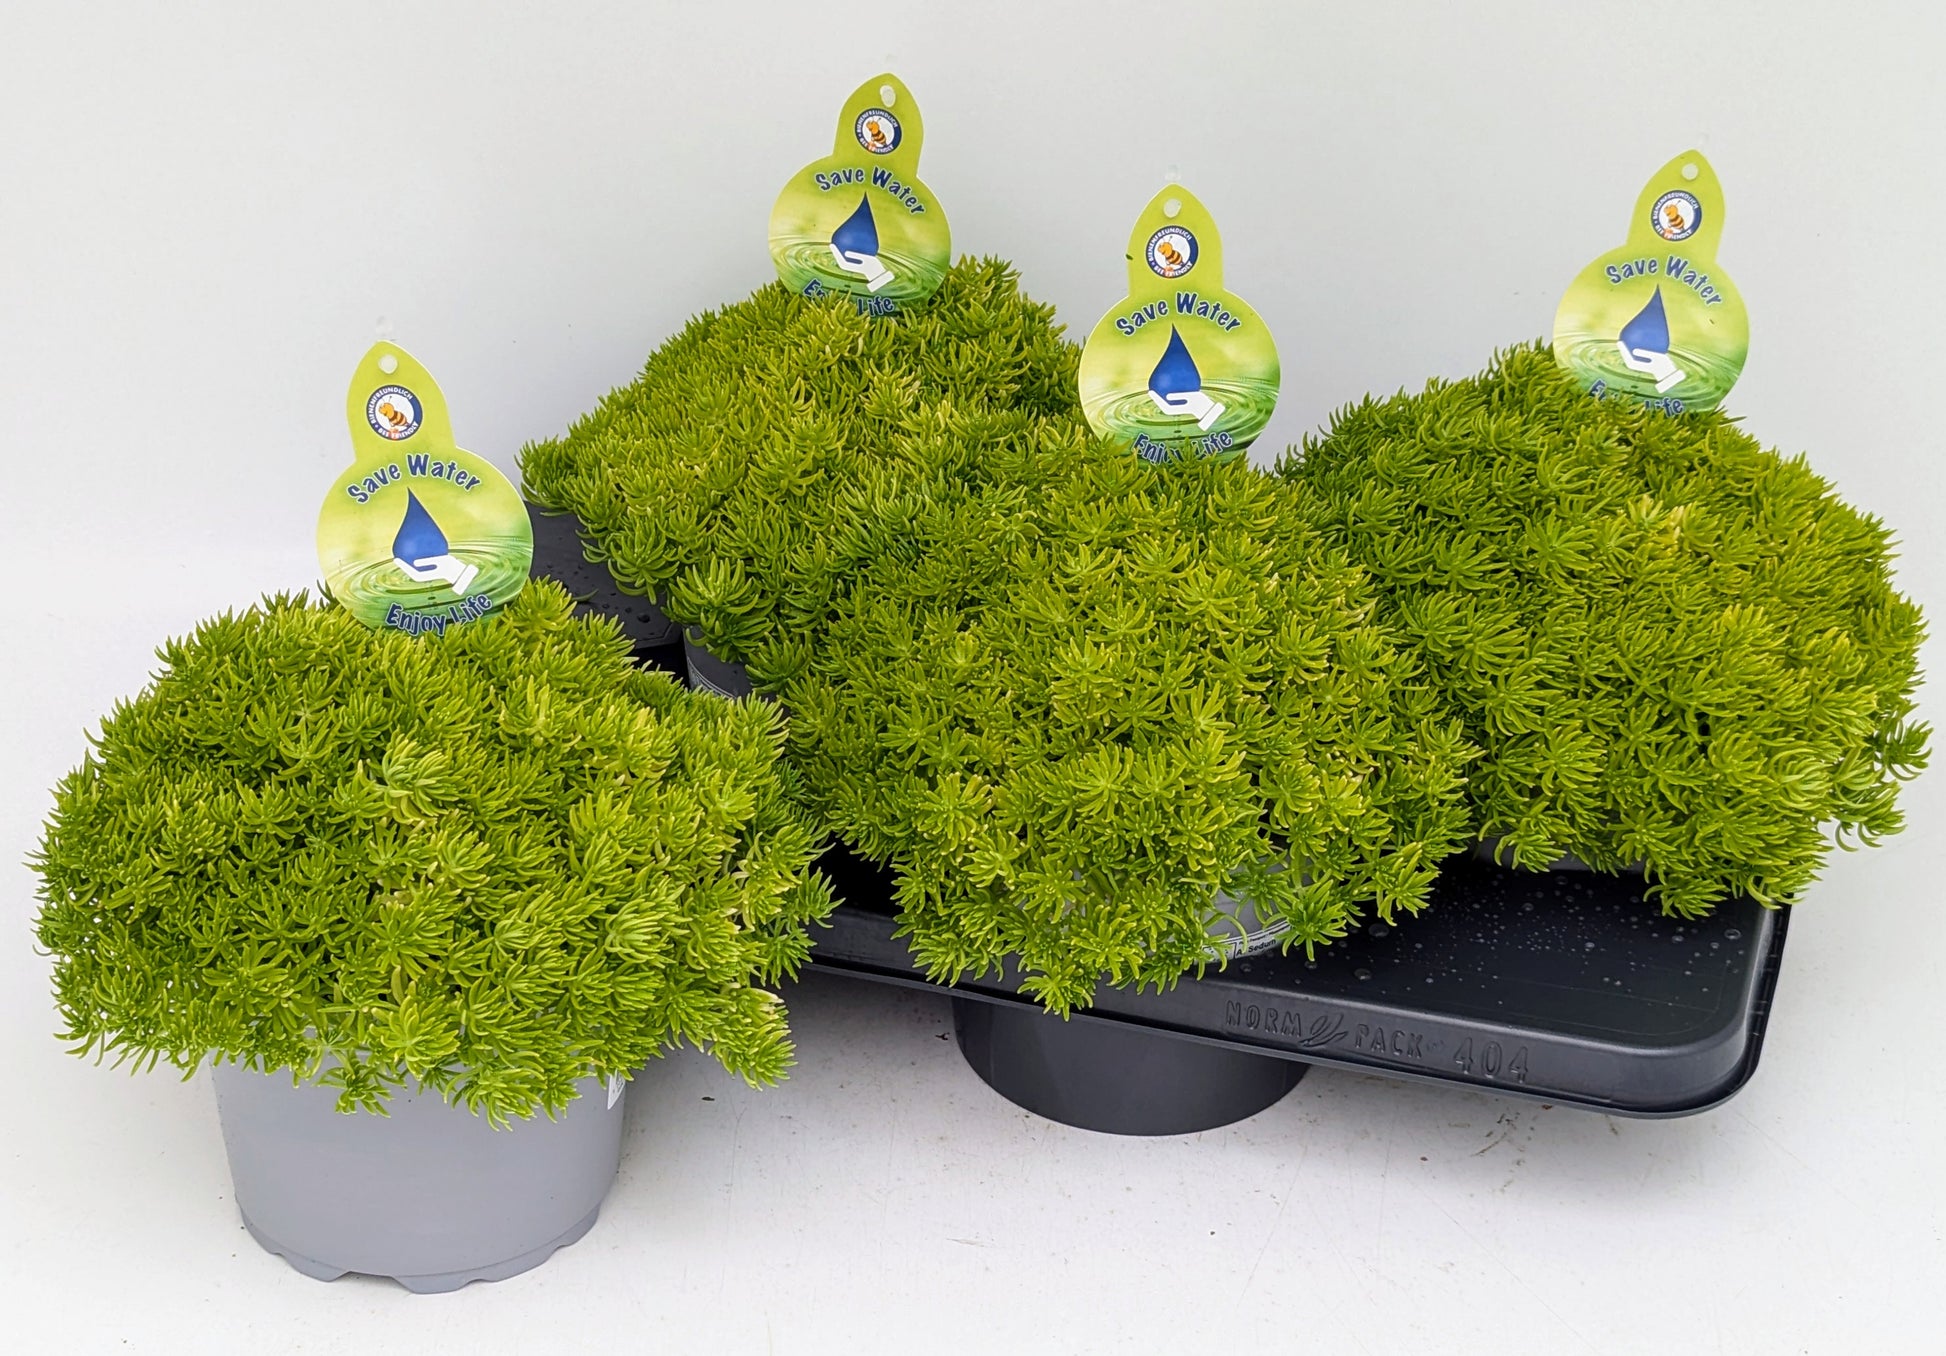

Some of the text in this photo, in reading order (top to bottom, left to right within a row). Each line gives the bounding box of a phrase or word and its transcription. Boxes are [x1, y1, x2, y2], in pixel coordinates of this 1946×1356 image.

[815, 166, 925, 214] Save Water
[1605, 255, 1722, 305] Save Water
[1115, 292, 1241, 335] Save Water
[347, 453, 481, 503] Save Water
[385, 594, 492, 636] Enjoy Life
[1247, 938, 1277, 954] Sedum
[1225, 1000, 1529, 1085] NORM PACK 404
